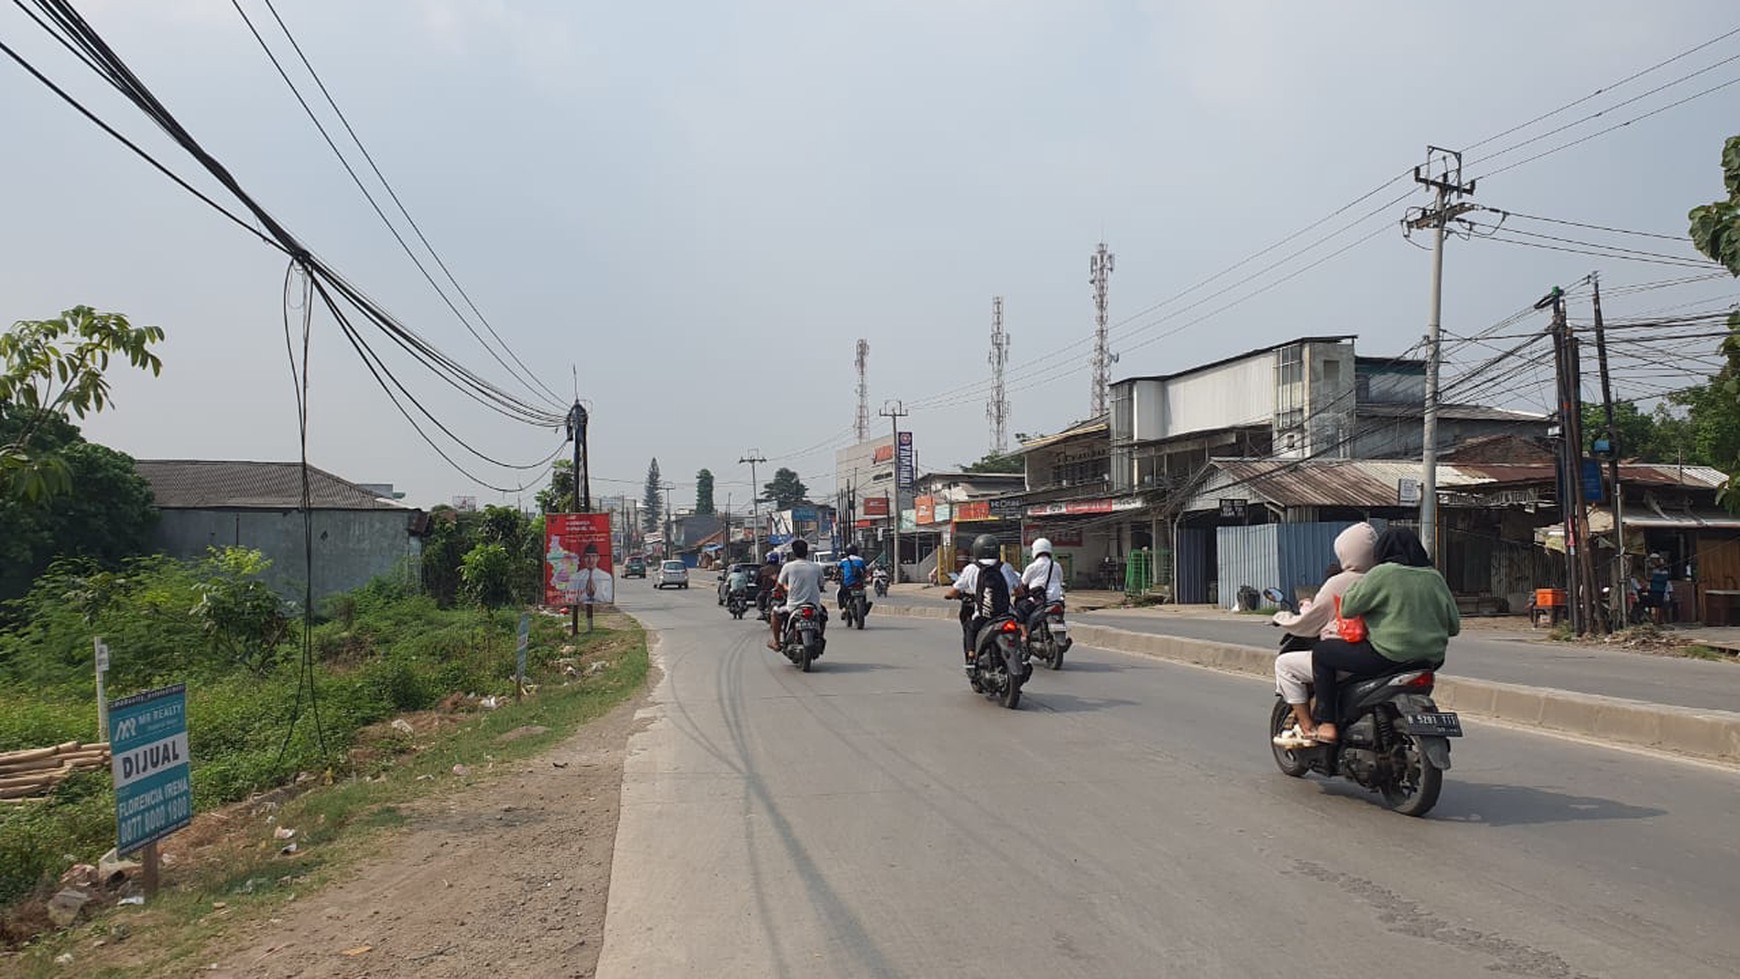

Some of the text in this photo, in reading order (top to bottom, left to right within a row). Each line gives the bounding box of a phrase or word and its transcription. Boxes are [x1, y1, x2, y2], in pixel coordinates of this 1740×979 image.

[899, 445, 912, 489] YAMAHA
[152, 705, 181, 720] REALTY
[122, 741, 180, 779] DIJUAL
